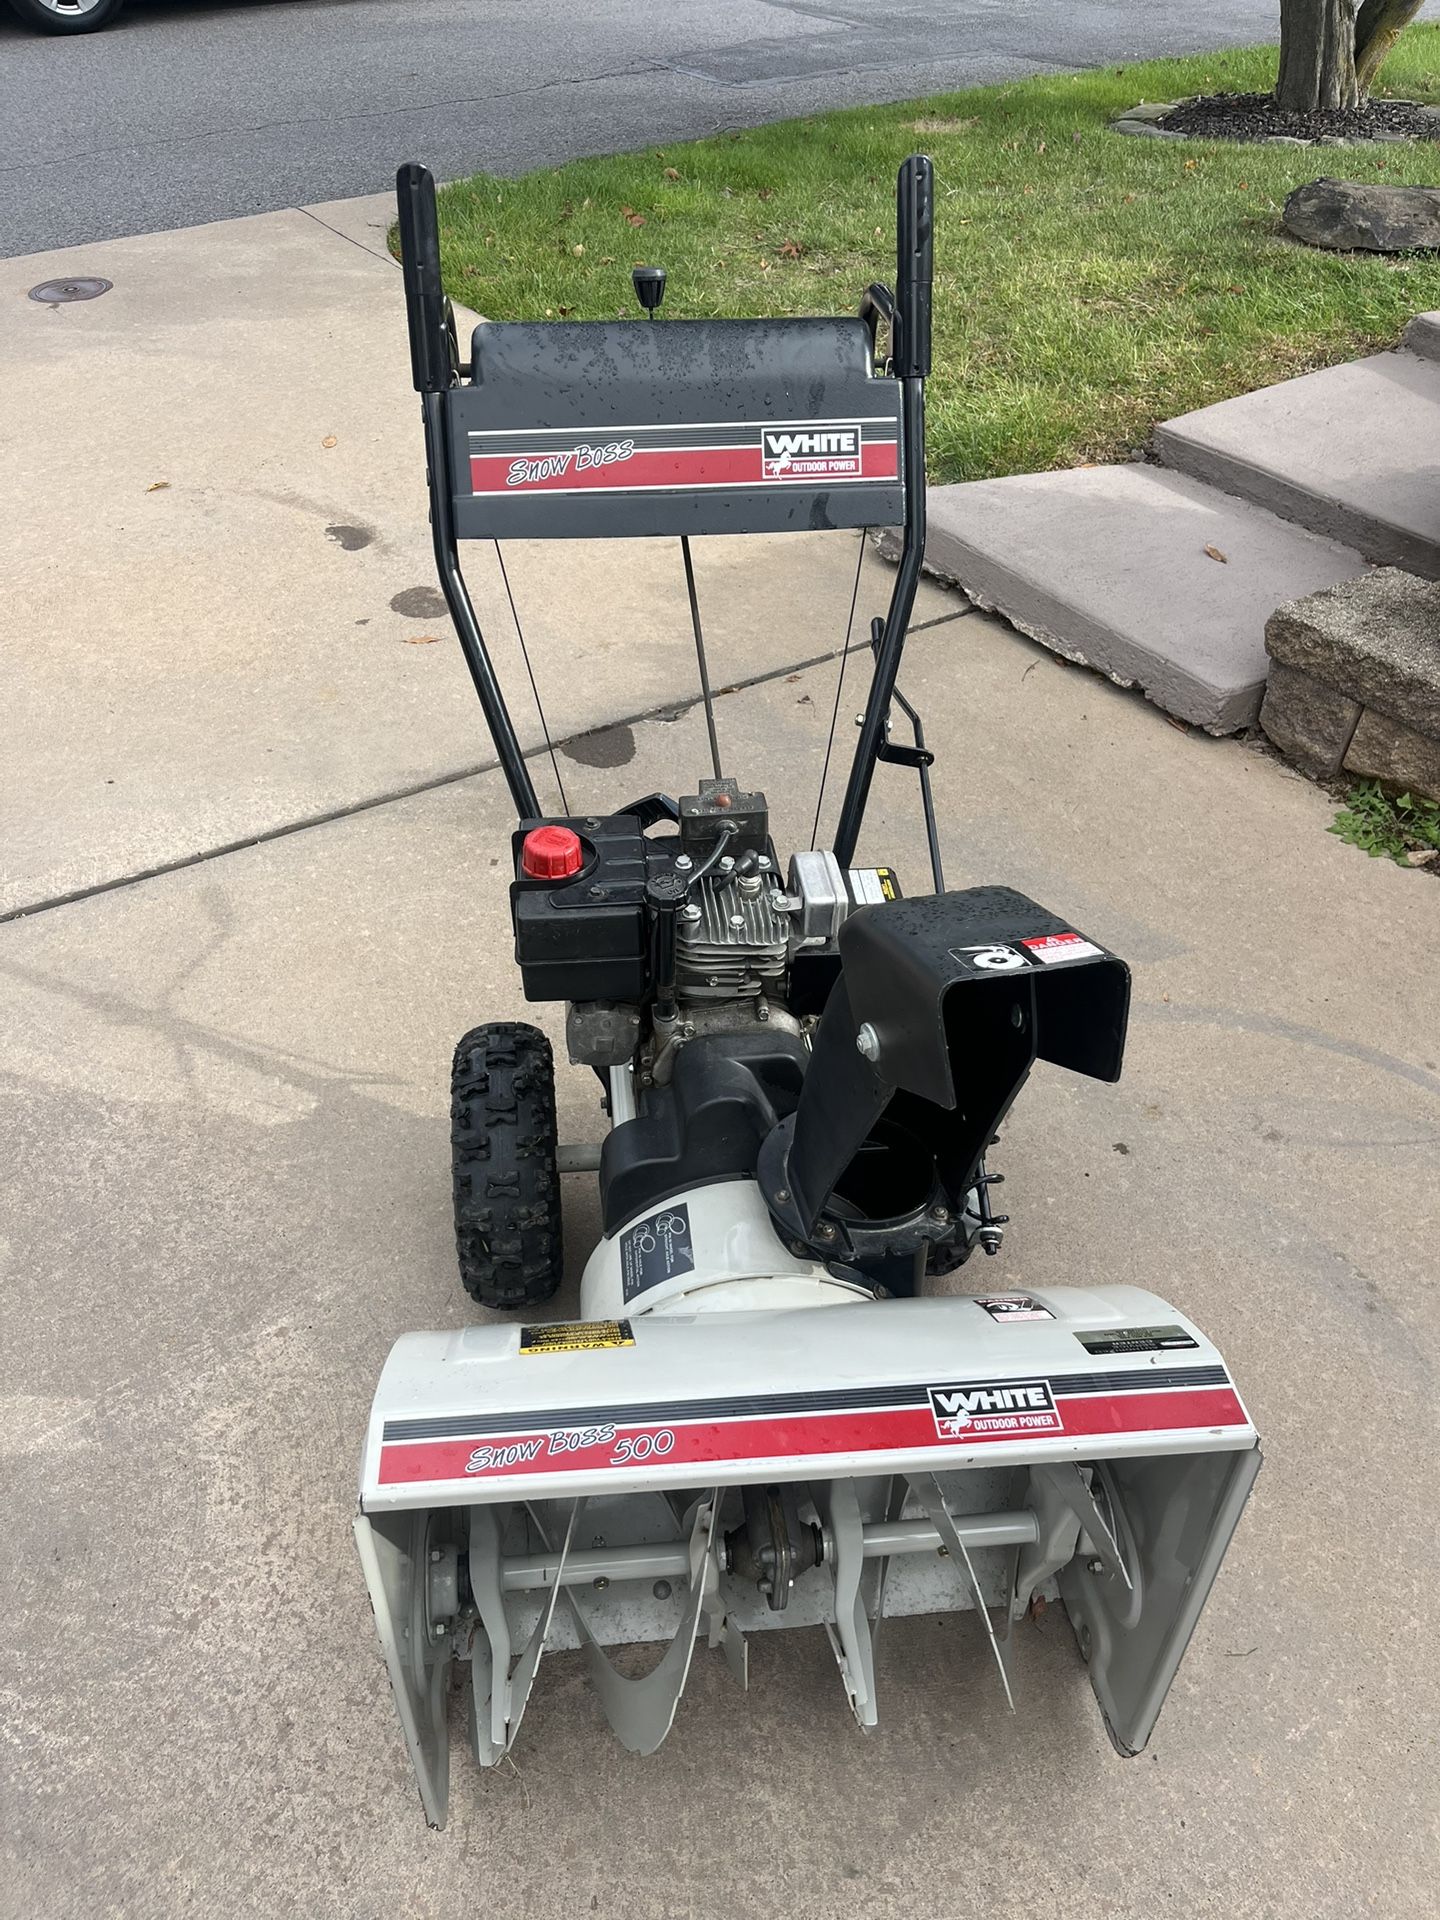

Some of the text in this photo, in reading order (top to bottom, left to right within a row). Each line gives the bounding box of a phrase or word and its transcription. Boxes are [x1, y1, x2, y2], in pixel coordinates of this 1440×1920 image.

[765, 432, 855, 454] WHITE
[792, 460, 856, 472] OUTDOOR POWER
[1028, 937, 1084, 950] DANGER
[528, 1342, 605, 1353] WARNING
[933, 1386, 1048, 1413] WHITE
[973, 1414, 1055, 1431] OUTDOOR POWER
[610, 1430, 674, 1465] 500
